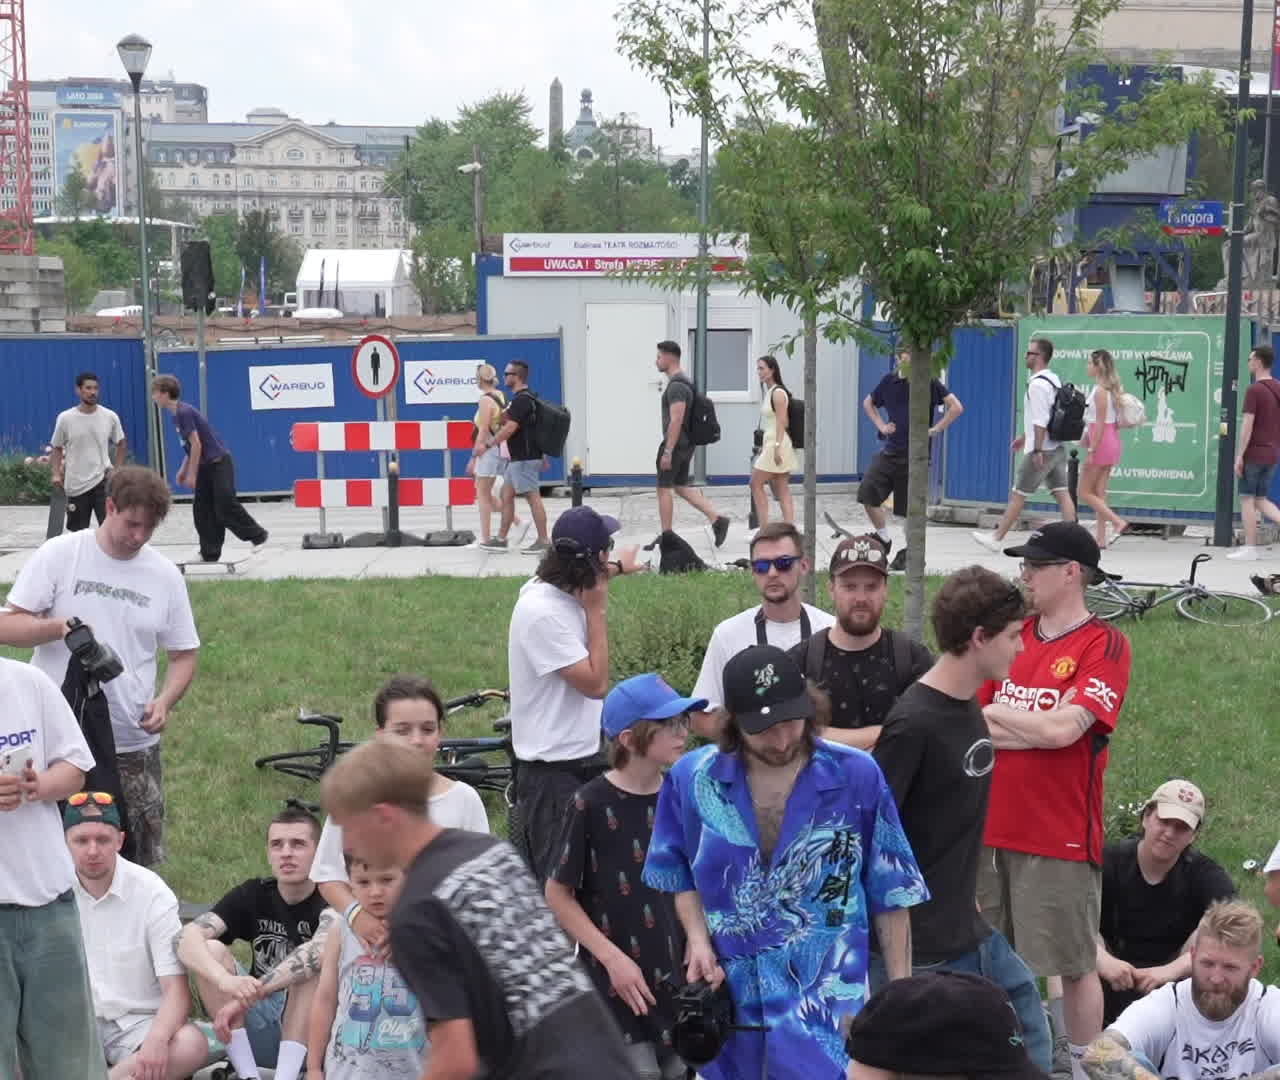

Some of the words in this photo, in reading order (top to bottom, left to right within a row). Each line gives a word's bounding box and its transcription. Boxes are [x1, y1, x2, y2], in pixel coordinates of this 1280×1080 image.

[543, 258, 583, 270] UWAGA
[1133, 351, 1193, 361] WARSZAWA
[269, 382, 325, 391] WARBUD
[424, 377, 478, 387] WARBUD
[1126, 468, 1195, 480] UTRUDNIENIA
